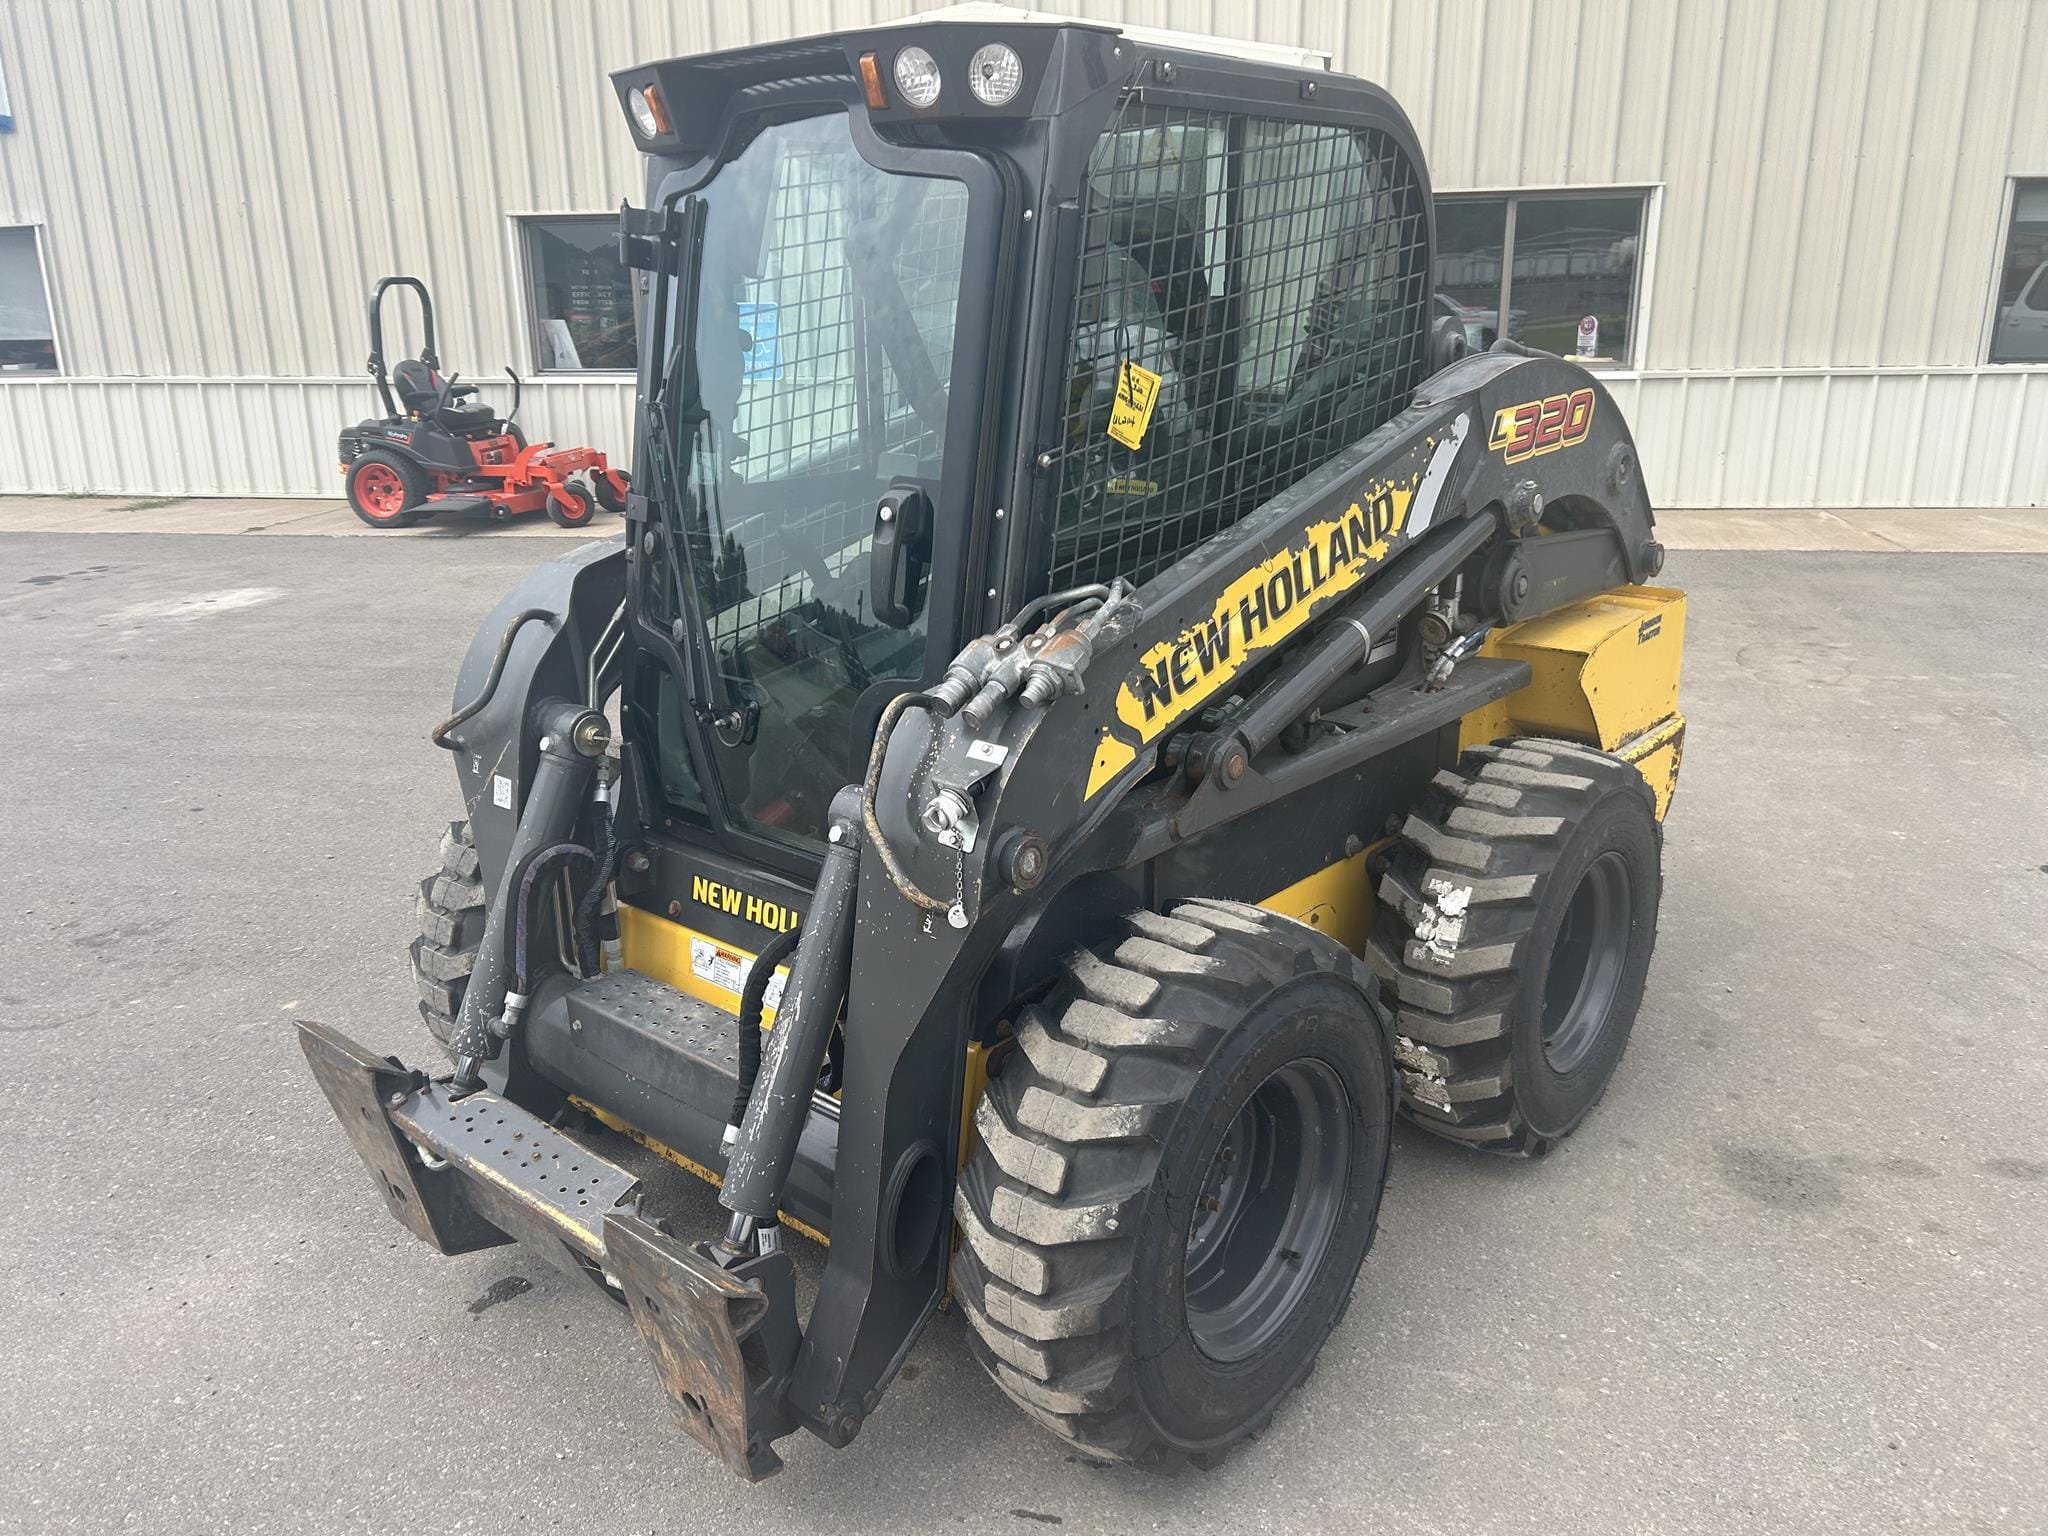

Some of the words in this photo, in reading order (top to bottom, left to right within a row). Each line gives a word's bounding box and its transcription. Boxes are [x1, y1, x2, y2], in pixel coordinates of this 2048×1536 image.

[1489, 388, 1595, 465] L320
[1141, 610, 1232, 722] NEW
[1239, 493, 1394, 644] HOLLAND
[692, 875, 743, 917] NEW
[745, 893, 799, 934] HOLL
